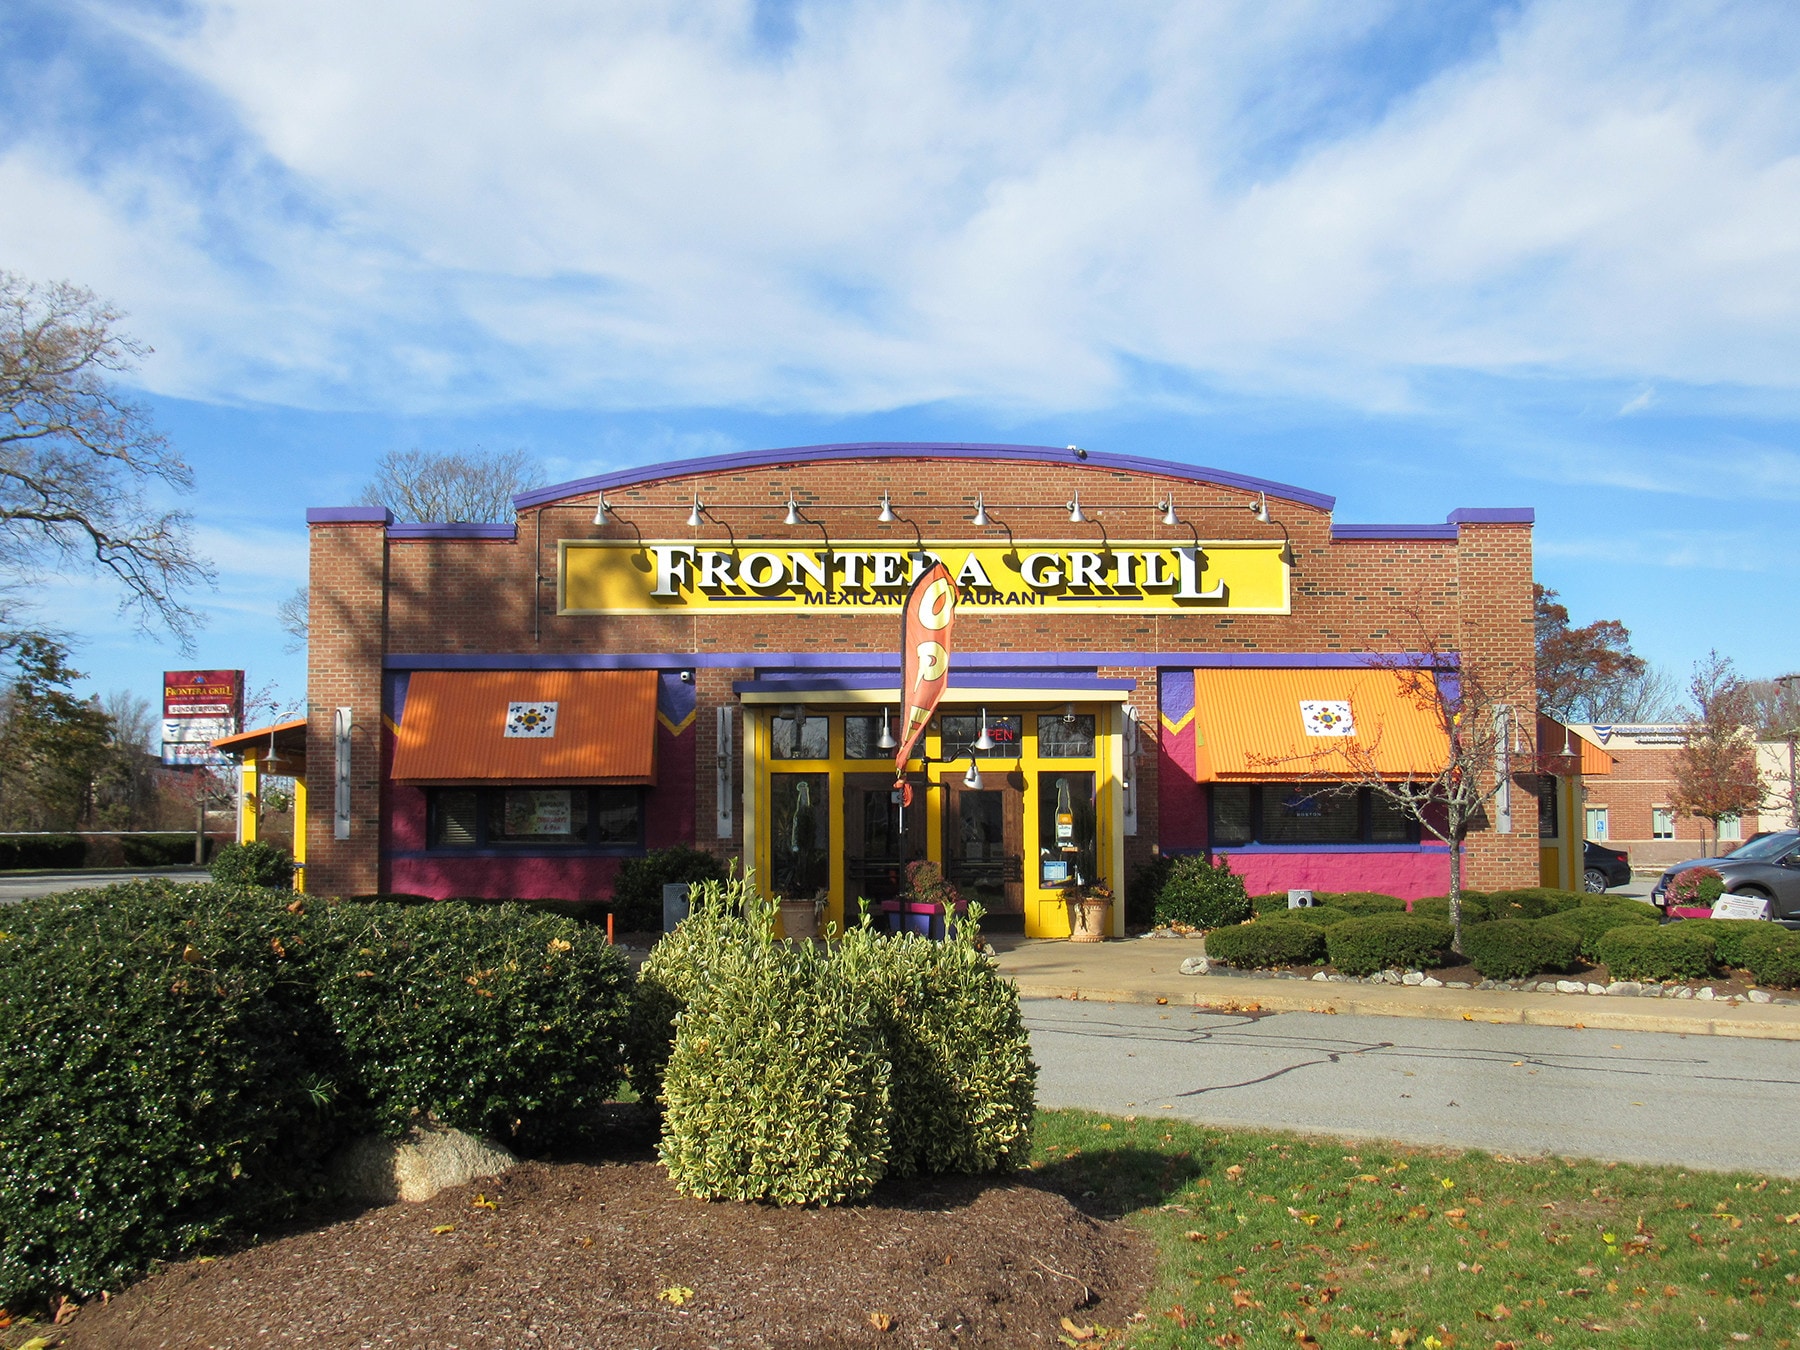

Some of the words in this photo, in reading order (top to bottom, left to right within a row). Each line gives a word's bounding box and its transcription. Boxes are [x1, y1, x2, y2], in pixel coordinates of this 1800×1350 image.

[1020, 546, 1225, 599] GRILL
[804, 591, 902, 605] MEXICAN
[960, 591, 1049, 606] AURANT
[904, 577, 956, 760] OPE
[165, 686, 207, 697] FRONTERA
[208, 685, 233, 696] GRILL
[198, 705, 226, 713] BRUNCH
[977, 728, 1013, 741] PEN
